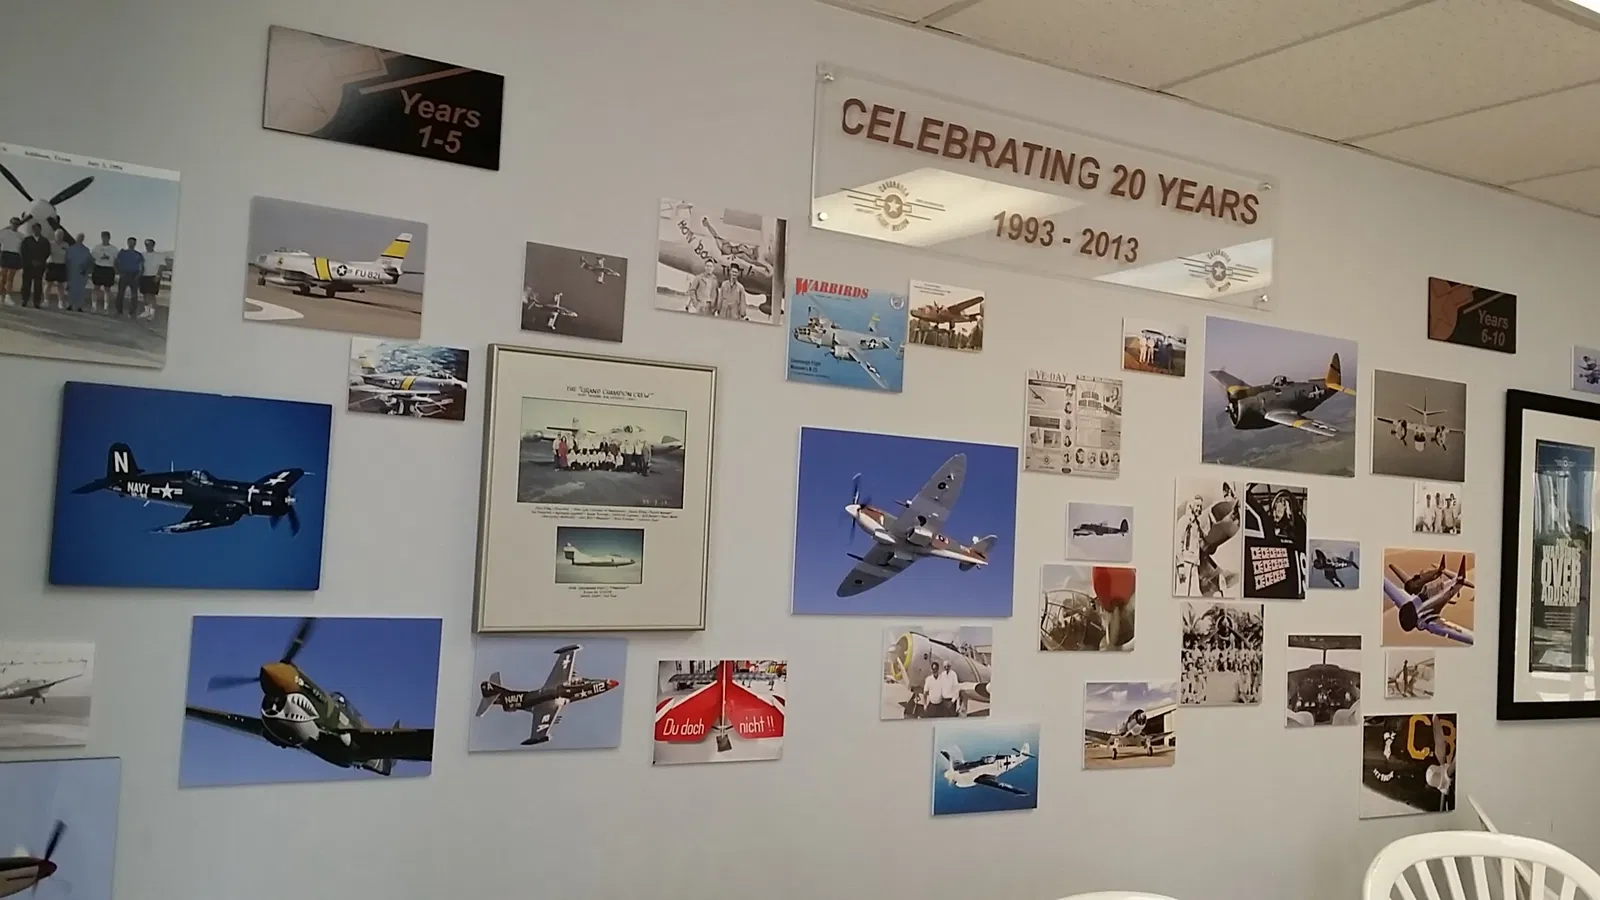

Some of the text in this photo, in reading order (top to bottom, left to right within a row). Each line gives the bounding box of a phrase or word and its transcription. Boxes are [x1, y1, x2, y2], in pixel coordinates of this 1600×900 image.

[401, 89, 481, 128] Years
[419, 125, 462, 154] 1-5
[842, 98, 1259, 225] CELEBRATING 20 YEARS
[993, 210, 1055, 247] 1993
[1080, 228, 1139, 263] 2013
[796, 277, 870, 299] WARBIRDS
[1478, 309, 1509, 330] Years
[1481, 328, 1506, 347] 6-10
[114, 451, 129, 474] N
[127, 481, 150, 493] NAVY
[1541, 558, 1582, 589] OVER
[504, 693, 524, 704] NAVY
[663, 718, 680, 736] Du
[681, 717, 705, 736] doch
[739, 715, 765, 734] nicht
